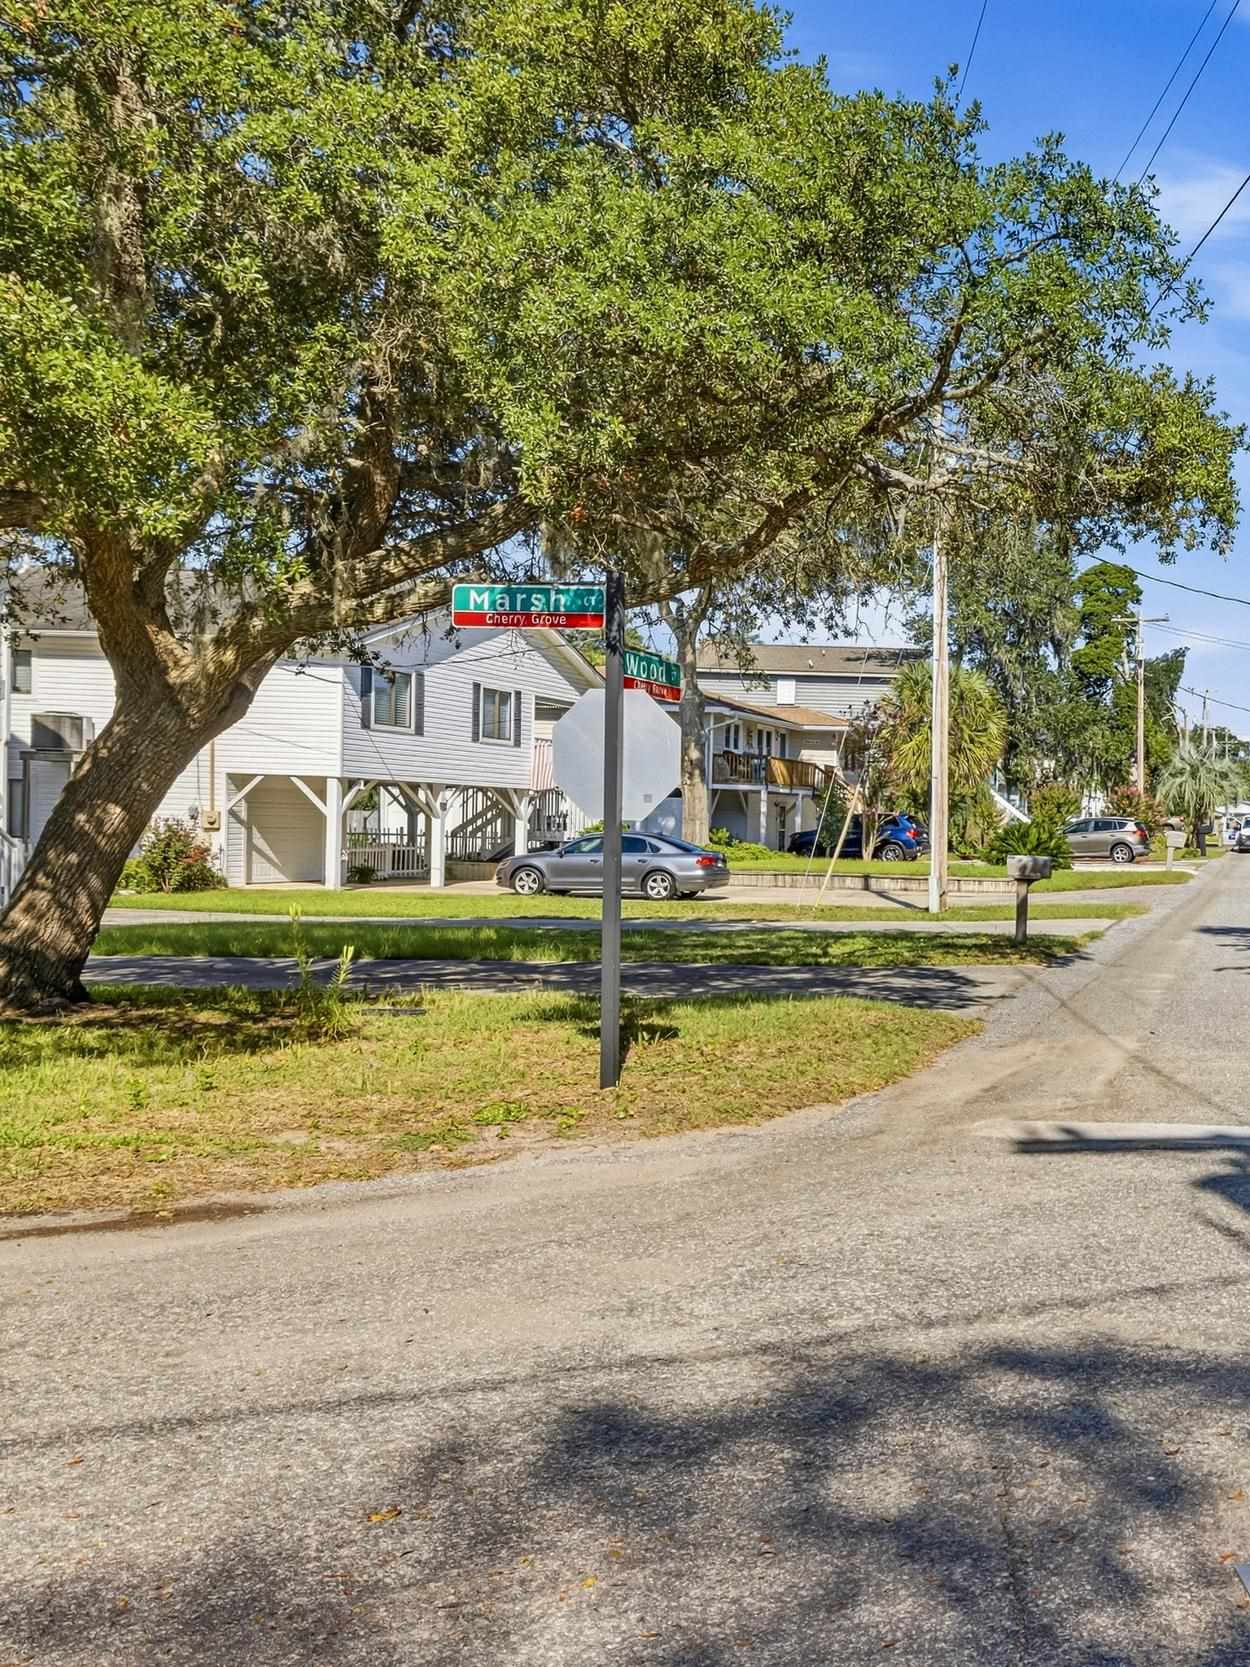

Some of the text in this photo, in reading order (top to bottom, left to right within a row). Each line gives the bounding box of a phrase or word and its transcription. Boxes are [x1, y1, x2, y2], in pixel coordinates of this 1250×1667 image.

[469, 589, 566, 612] Marsh
[486, 613, 567, 626] Cherry Grove
[626, 653, 666, 682] Wood
